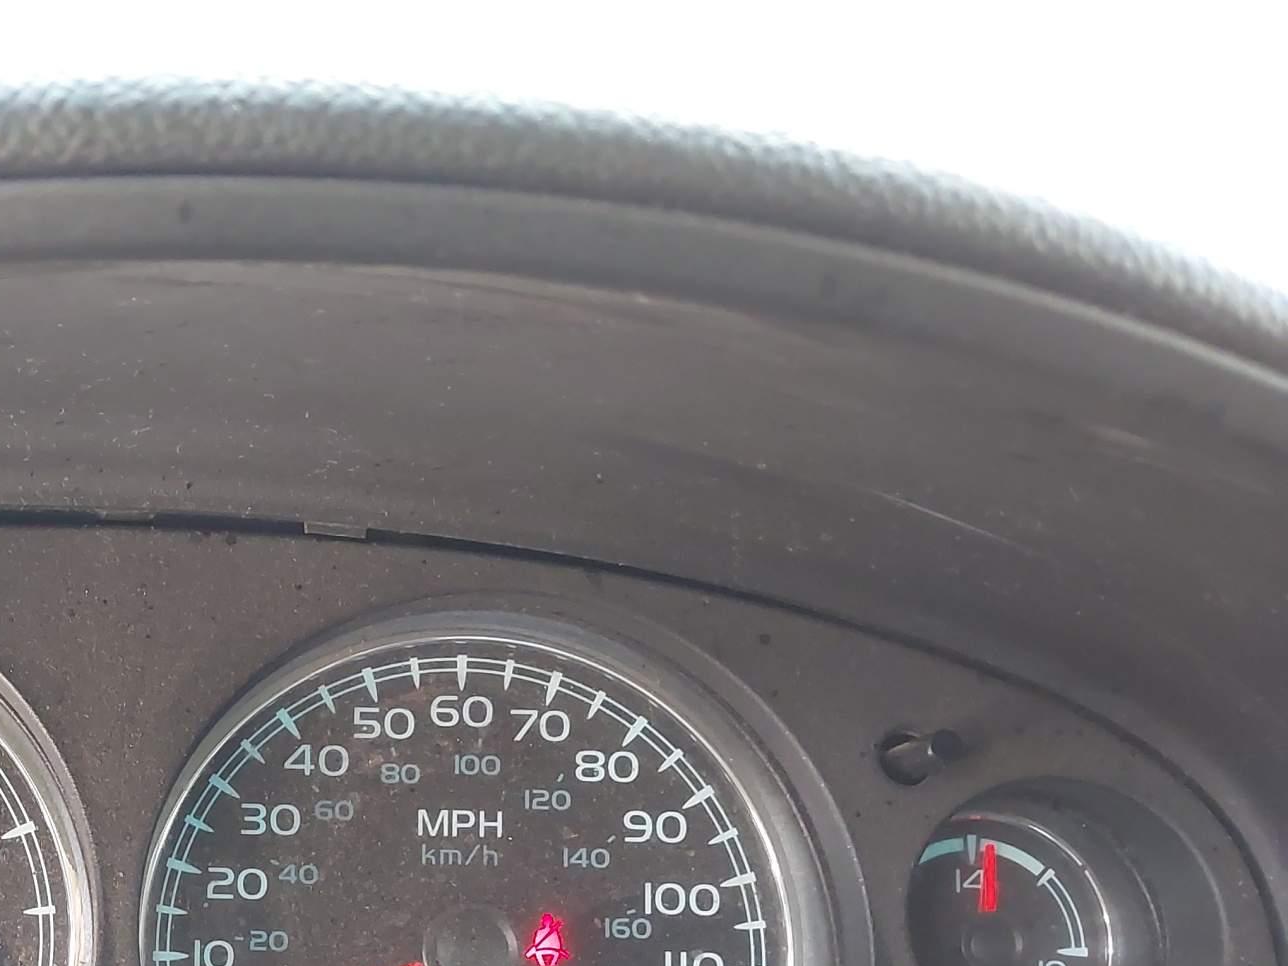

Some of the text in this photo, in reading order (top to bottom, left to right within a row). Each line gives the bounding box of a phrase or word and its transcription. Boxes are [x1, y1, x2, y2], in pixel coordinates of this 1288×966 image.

[353, 706, 416, 740] 50
[430, 695, 494, 728] 60
[510, 709, 571, 742] 70
[284, 744, 350, 777] 40
[380, 763, 421, 784] 80
[454, 755, 501, 776] 100
[575, 750, 639, 783] 80
[314, 800, 353, 821] 60
[524, 789, 572, 811] 120
[240, 803, 301, 836] 30
[417, 810, 503, 838] MPH
[623, 811, 688, 844] 90
[421, 845, 499, 867] km/h
[562, 848, 610, 869] 140
[207, 867, 268, 900] 20
[278, 865, 320, 885] 40
[644, 883, 720, 917] 100
[249, 930, 289, 953] 20
[604, 918, 652, 939] 160
